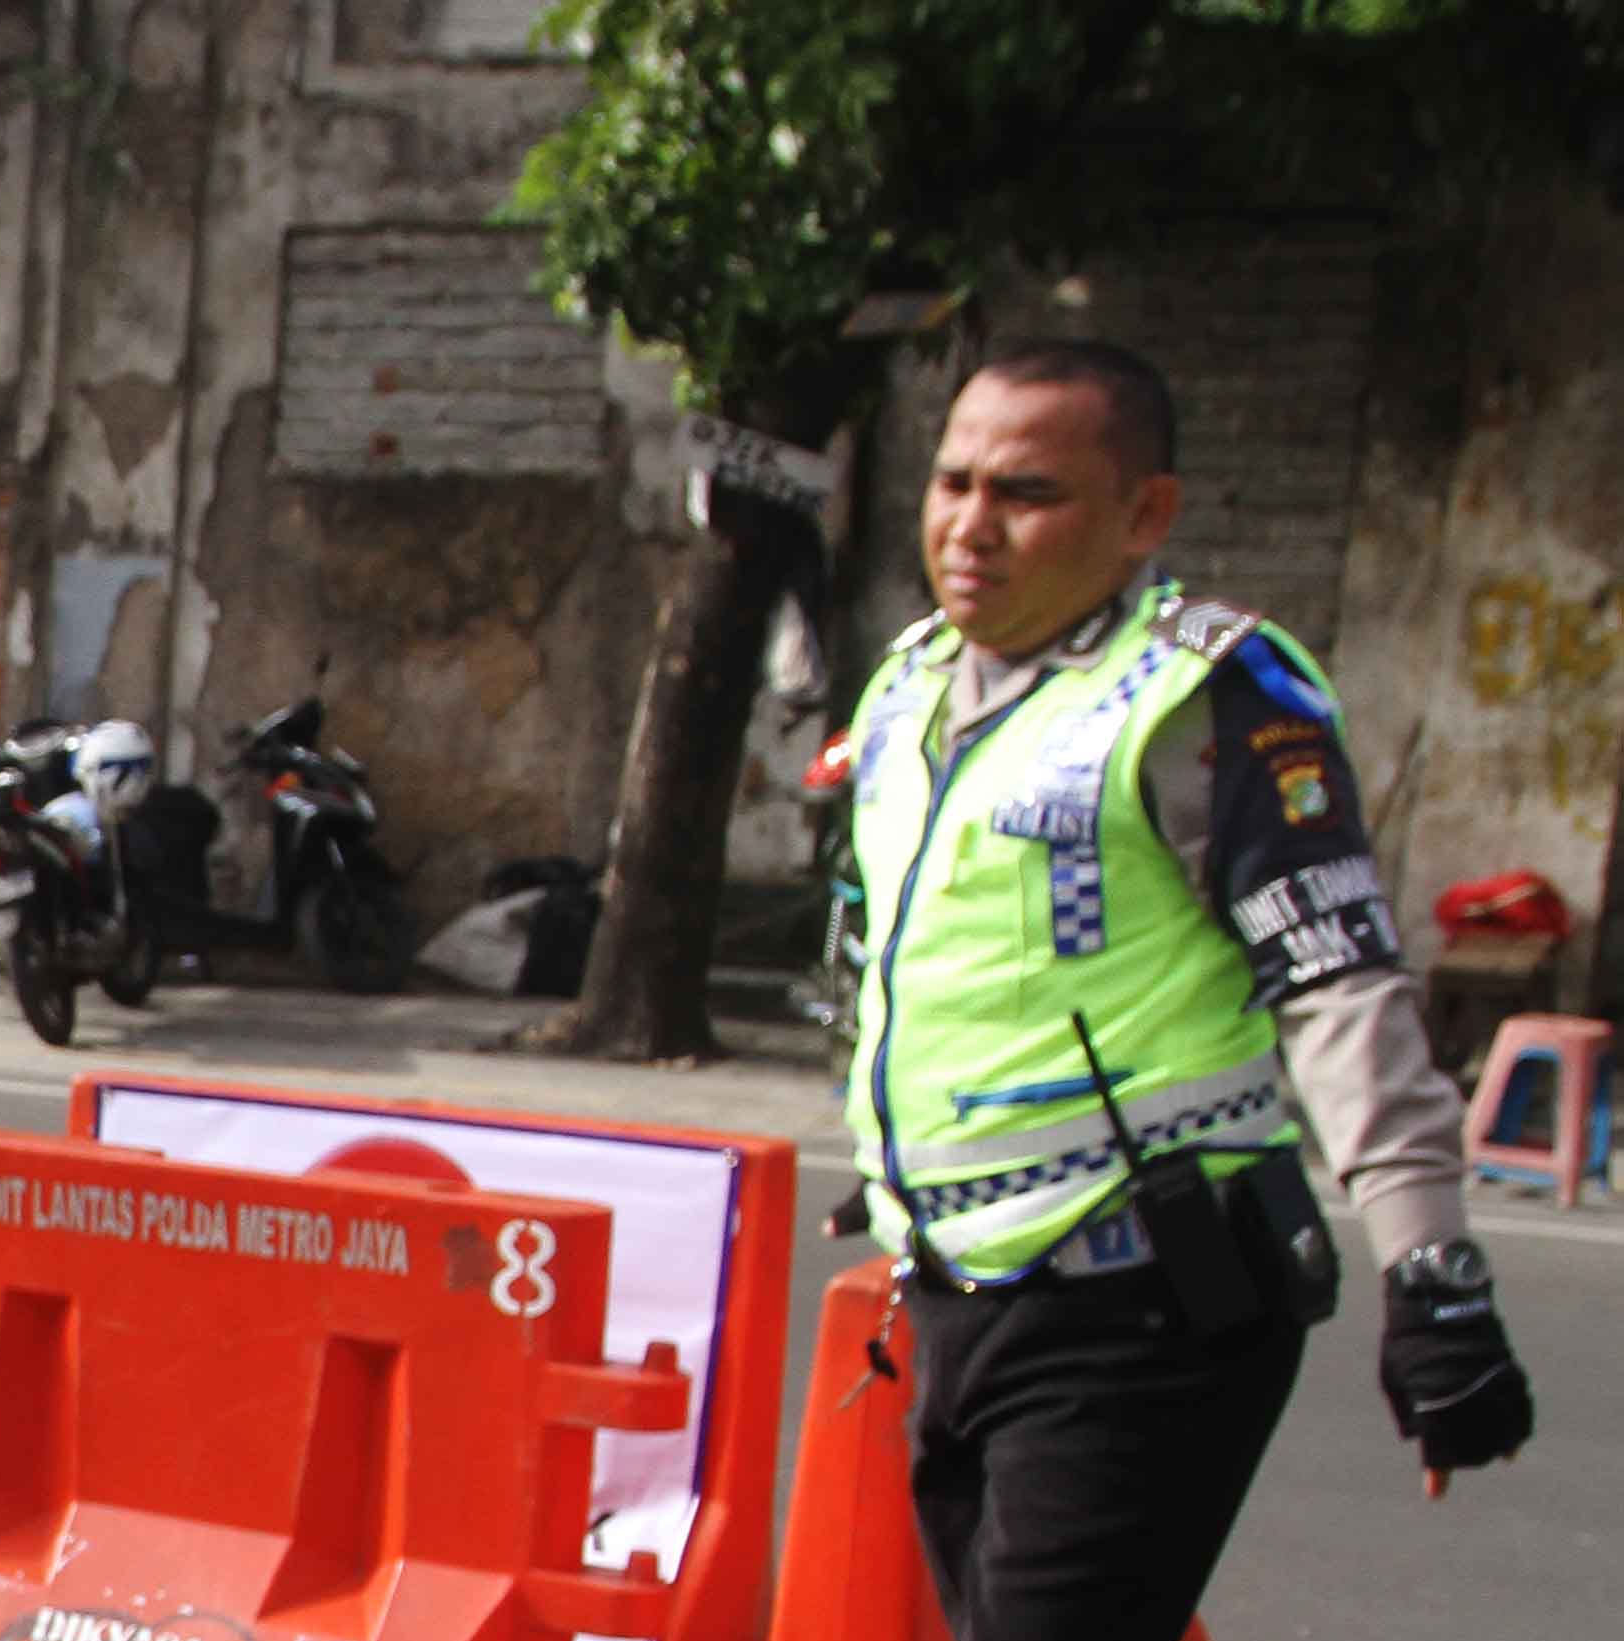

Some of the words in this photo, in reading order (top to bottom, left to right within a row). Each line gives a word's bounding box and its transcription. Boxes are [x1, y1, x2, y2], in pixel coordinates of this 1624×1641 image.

[33, 1179, 134, 1240] LANTAS
[141, 1192, 228, 1252] POLDA
[237, 1203, 332, 1264] METRO
[341, 1216, 409, 1277] JAYA
[489, 1218, 557, 1319] 8
